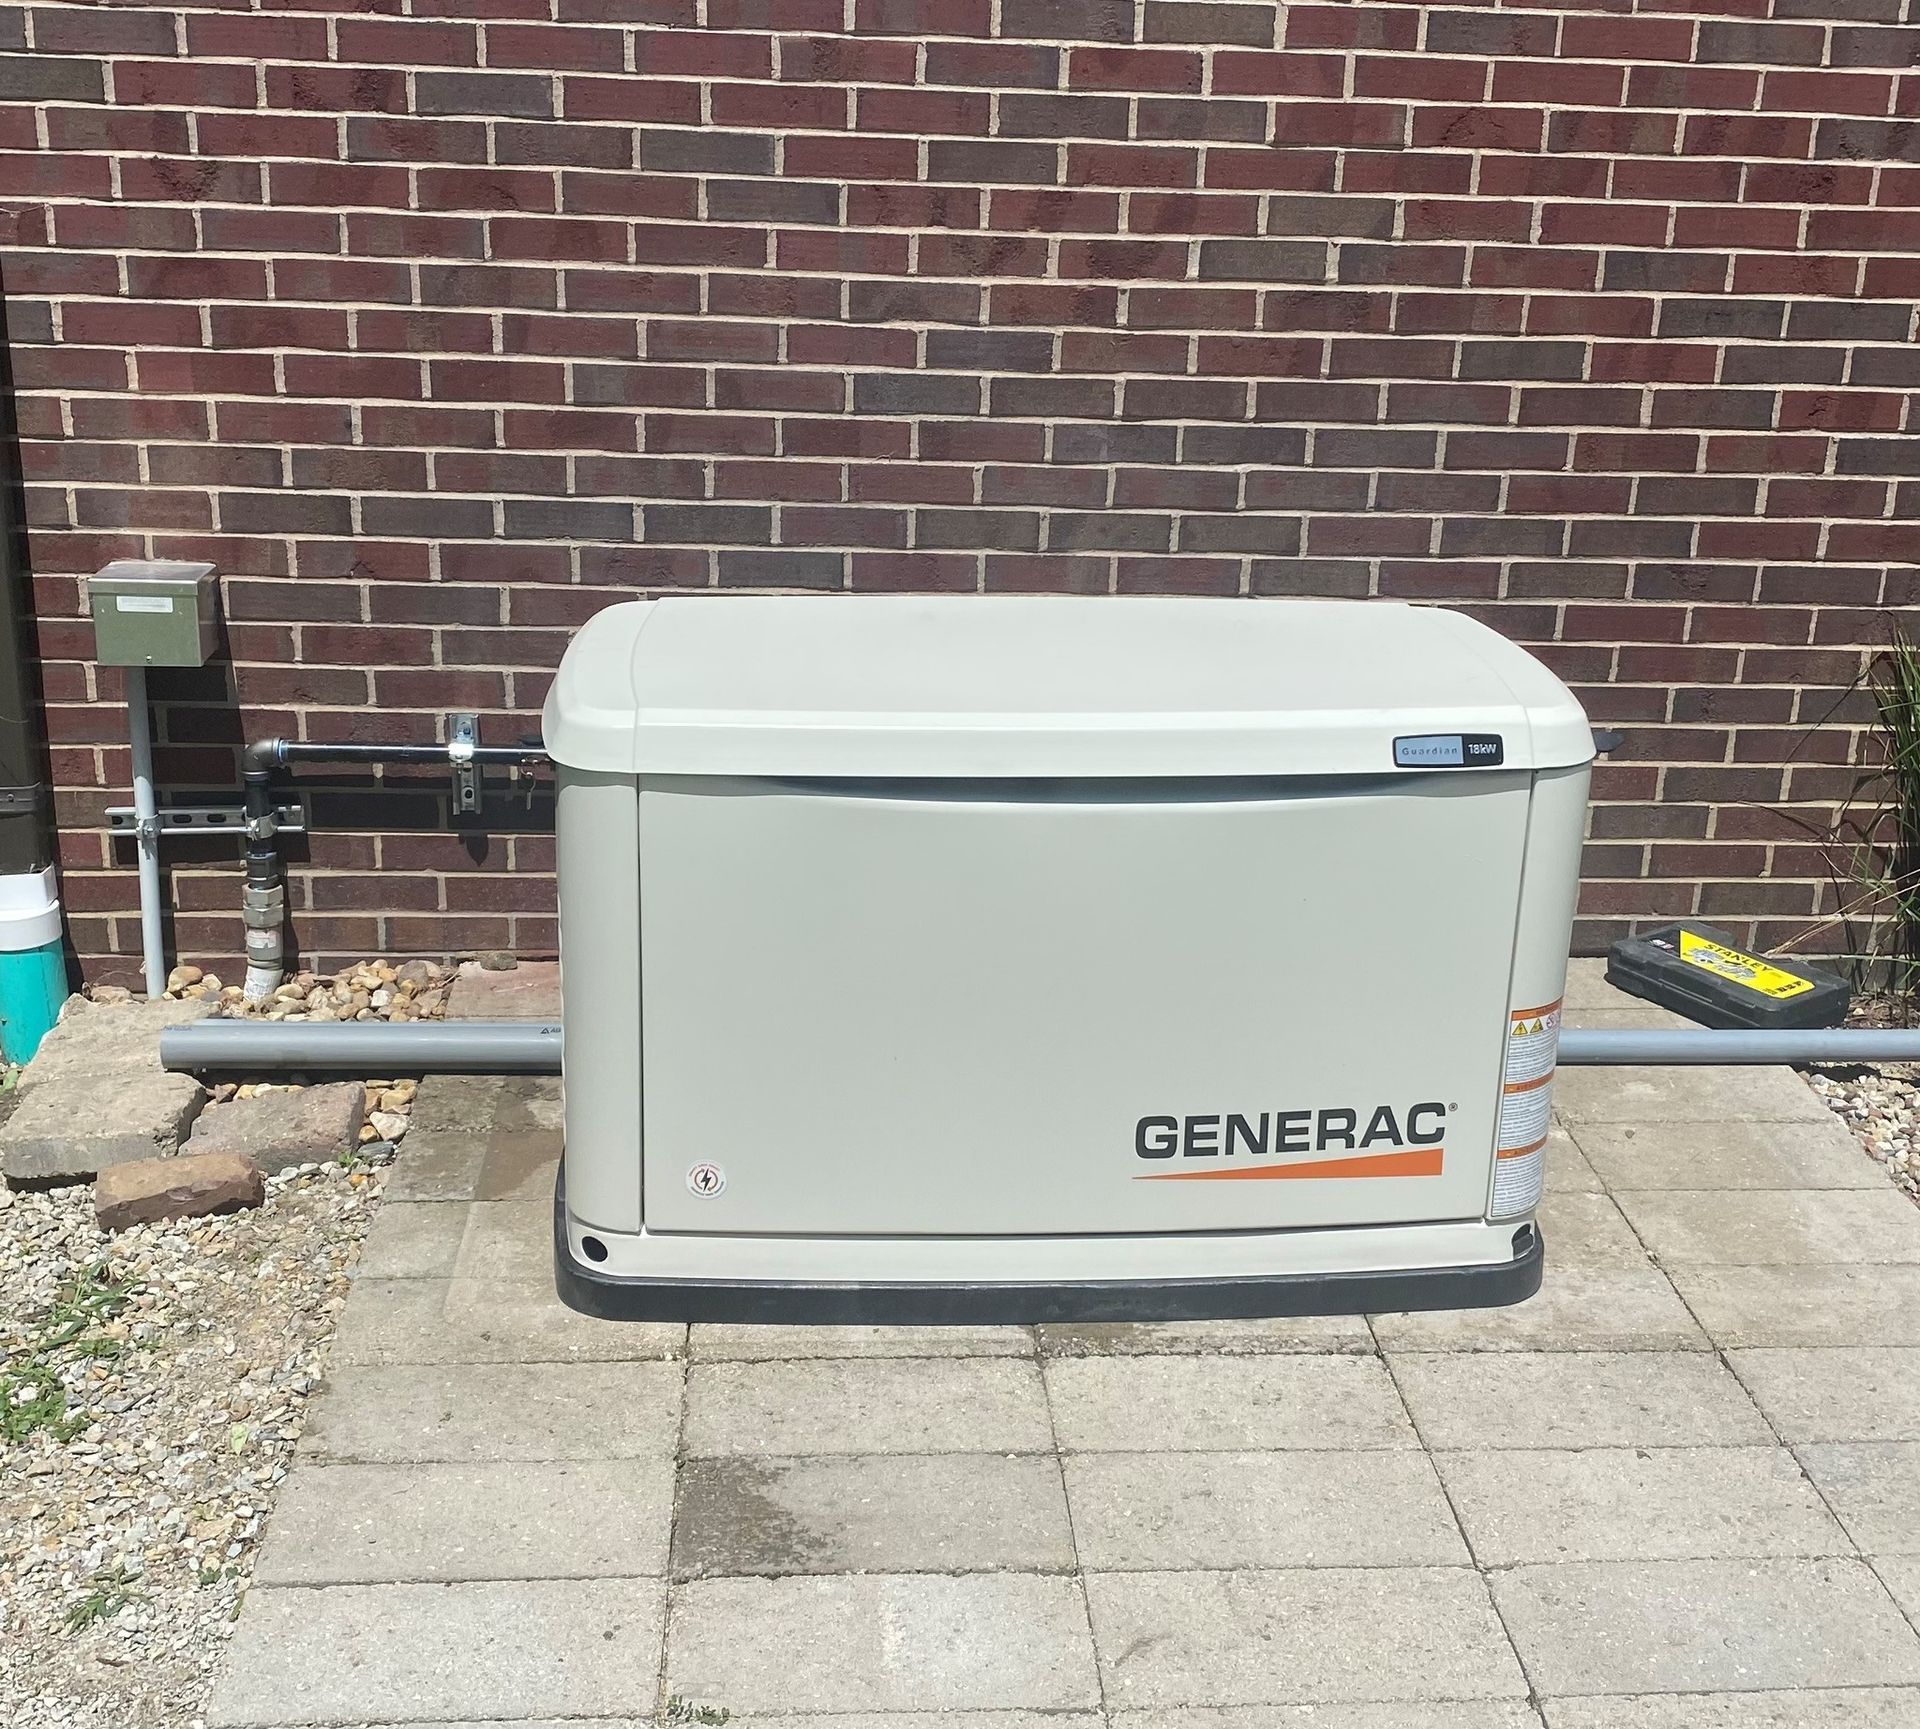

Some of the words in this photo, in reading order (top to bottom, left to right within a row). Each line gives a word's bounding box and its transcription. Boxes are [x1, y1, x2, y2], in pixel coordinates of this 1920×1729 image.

[1402, 747, 1458, 756] Guardian
[1468, 744, 1497, 755] 18kW
[1703, 944, 1775, 972] STANLEY
